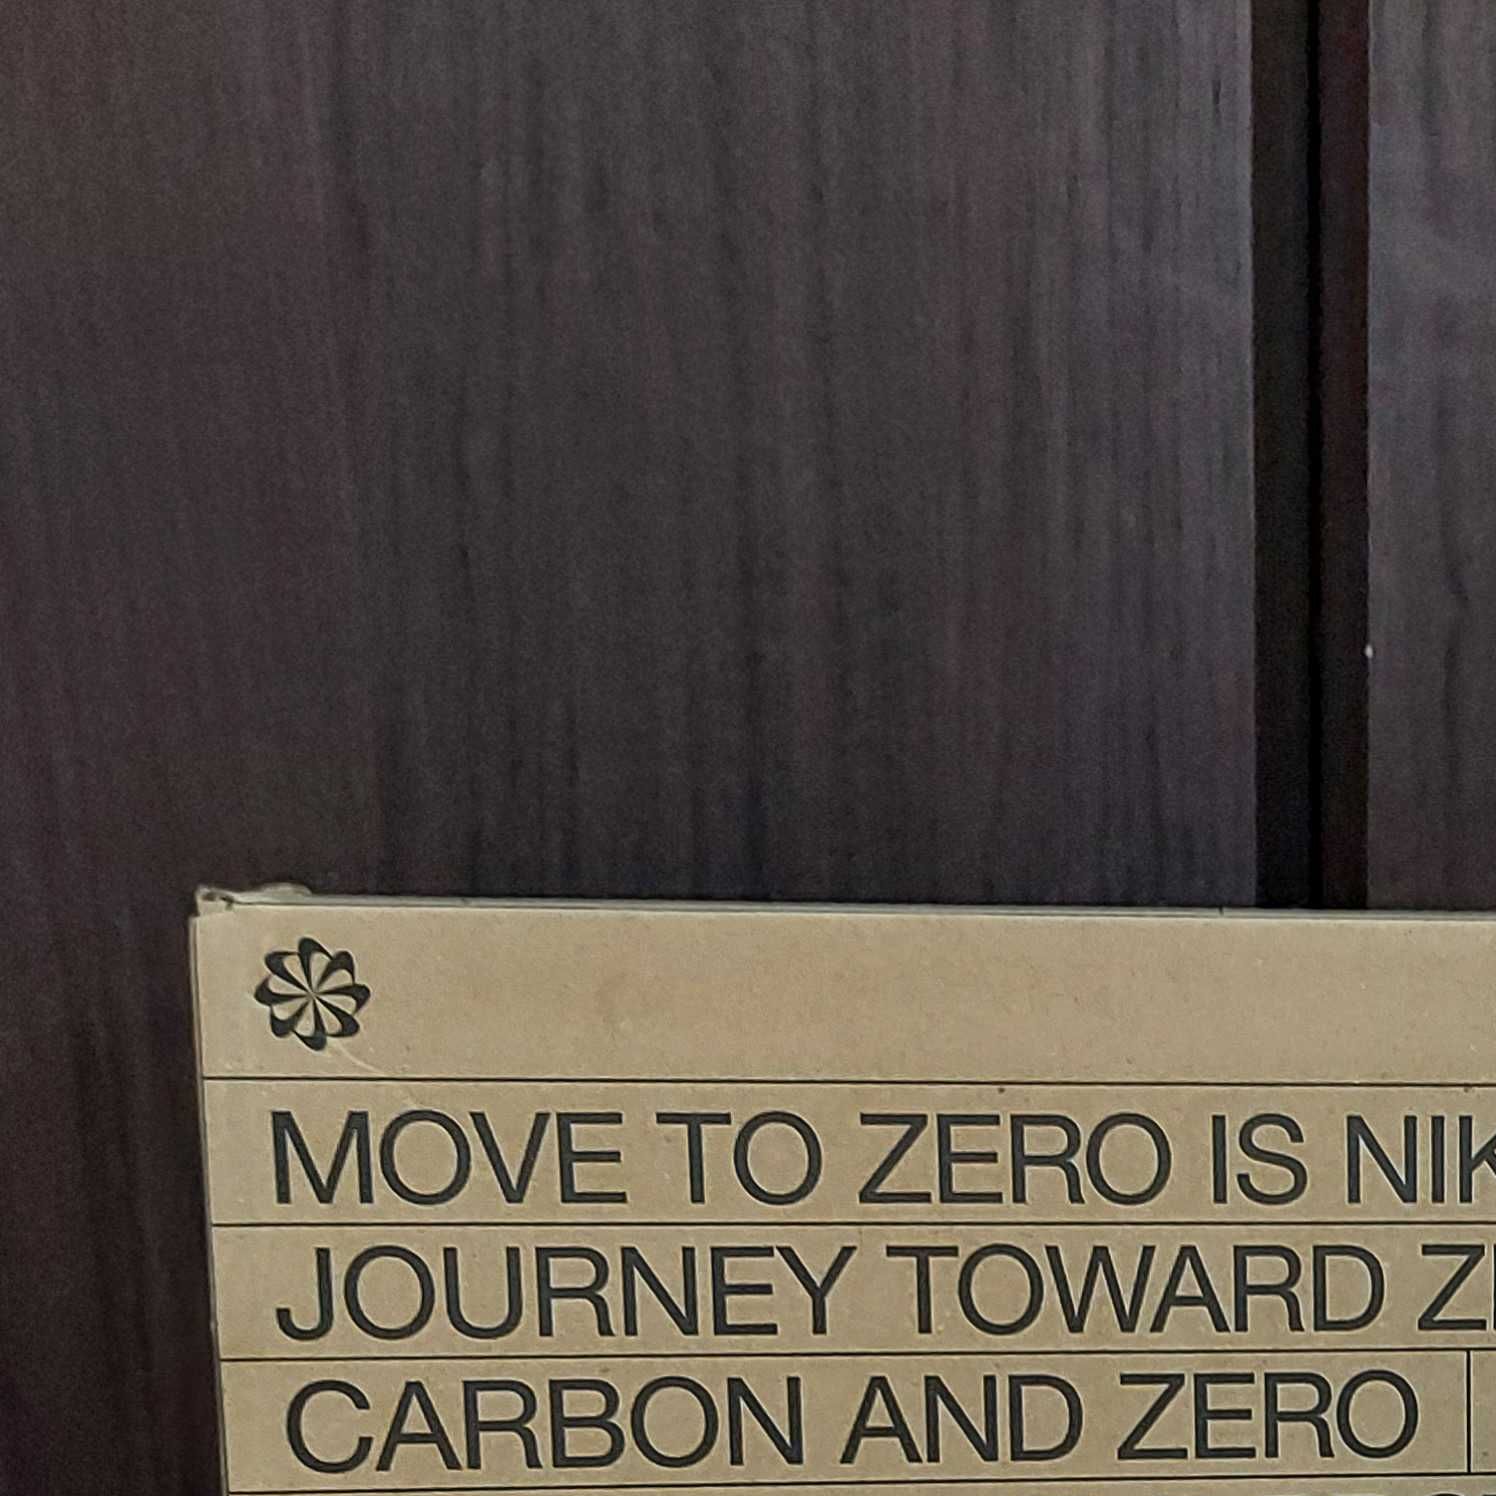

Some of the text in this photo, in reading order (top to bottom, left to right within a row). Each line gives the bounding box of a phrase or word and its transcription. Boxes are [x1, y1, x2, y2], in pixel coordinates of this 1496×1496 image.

[271, 1109, 628, 1206] MOVE
[655, 1110, 822, 1206] TO
[858, 1112, 1172, 1206] ZERO
[1211, 1112, 1308, 1206] IS
[275, 1245, 858, 1342] JOURNEY
[885, 1243, 1385, 1336] TOWARD
[285, 1369, 1419, 1475] CARBON AND ZERO
